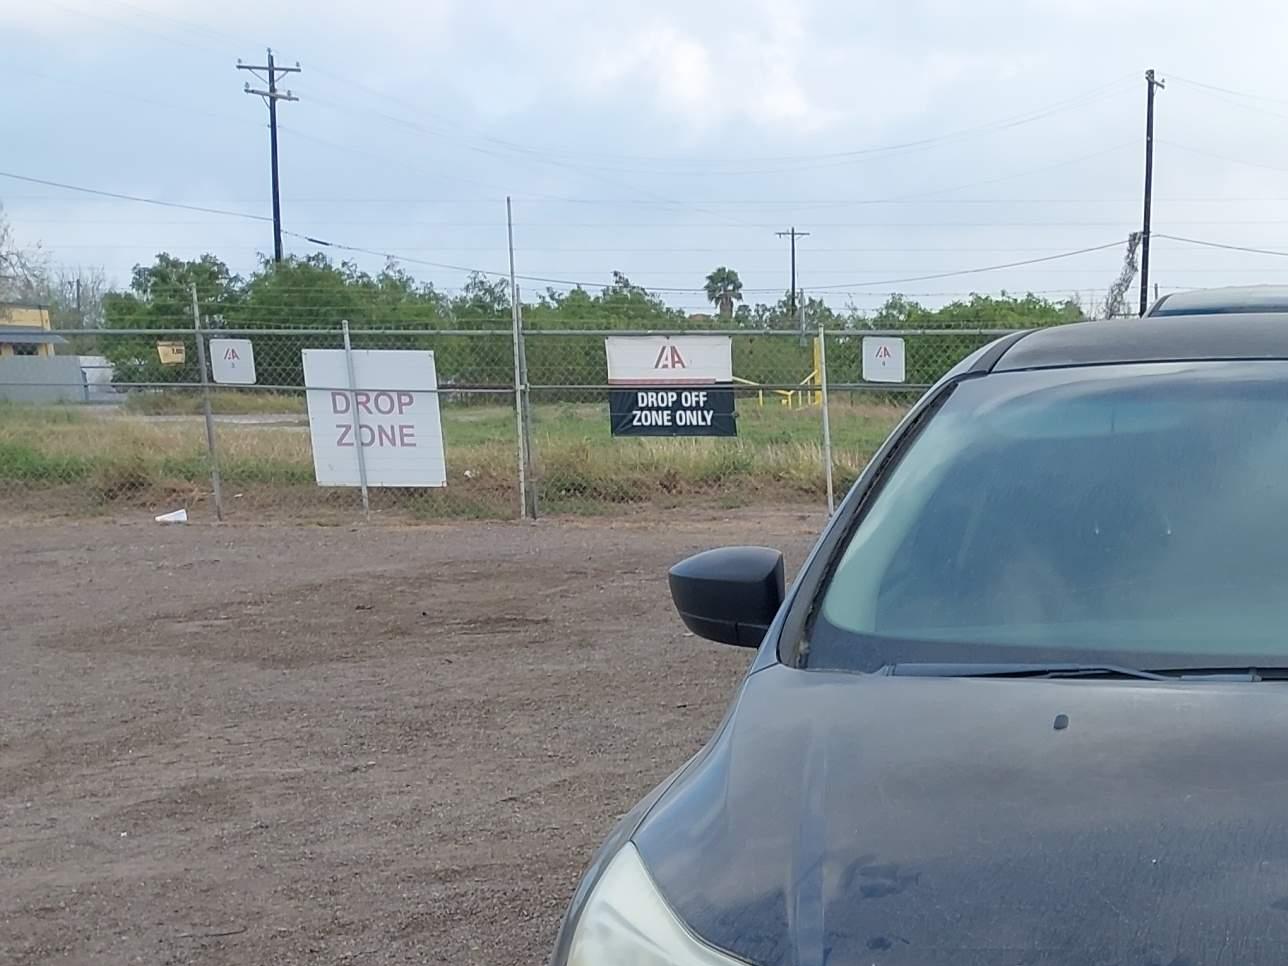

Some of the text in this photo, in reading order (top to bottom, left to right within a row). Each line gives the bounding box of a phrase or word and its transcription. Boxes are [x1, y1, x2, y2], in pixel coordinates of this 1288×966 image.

[331, 391, 414, 415] DROP
[637, 391, 708, 408] DROP OFF
[632, 410, 713, 426] ZONE ONLY
[336, 424, 417, 447] ZONE
